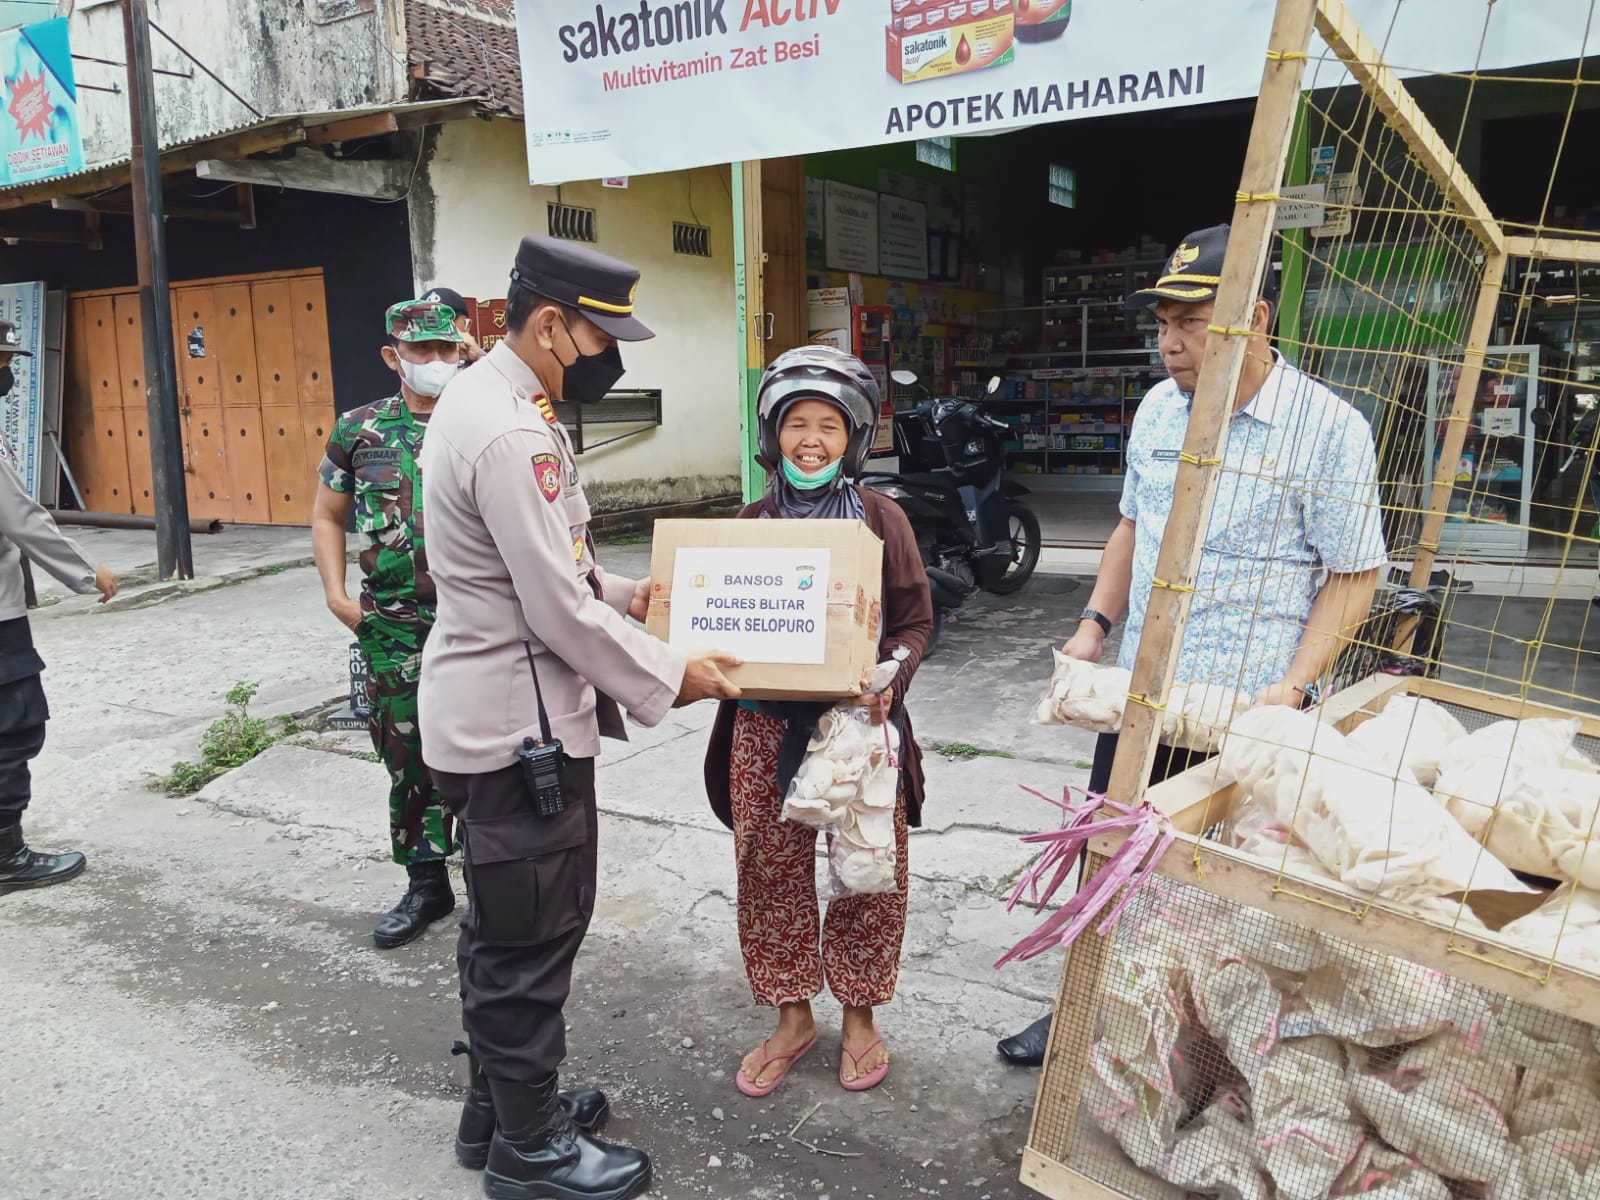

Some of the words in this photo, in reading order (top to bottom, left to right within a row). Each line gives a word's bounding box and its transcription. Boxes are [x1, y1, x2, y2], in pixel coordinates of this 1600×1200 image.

[558, 0, 727, 63] sakatonik
[904, 35, 948, 56] sakatonik
[602, 51, 724, 92] Multivitamin
[729, 44, 769, 70] Zat
[774, 33, 821, 64] Besi
[885, 91, 1004, 136] APOTEK
[1012, 64, 1206, 118] MAHARANI
[31, 143, 69, 160] SETIAWAN
[14, 297, 23, 330] LAUT
[11, 393, 21, 451] PESAWAT
[723, 574, 784, 586] BANSOS
[706, 597, 756, 610] POLRES
[759, 598, 805, 611] BLITAR
[691, 616, 741, 632] POLSEK
[744, 617, 815, 634] SELOPURO
[350, 648, 363, 661] R
